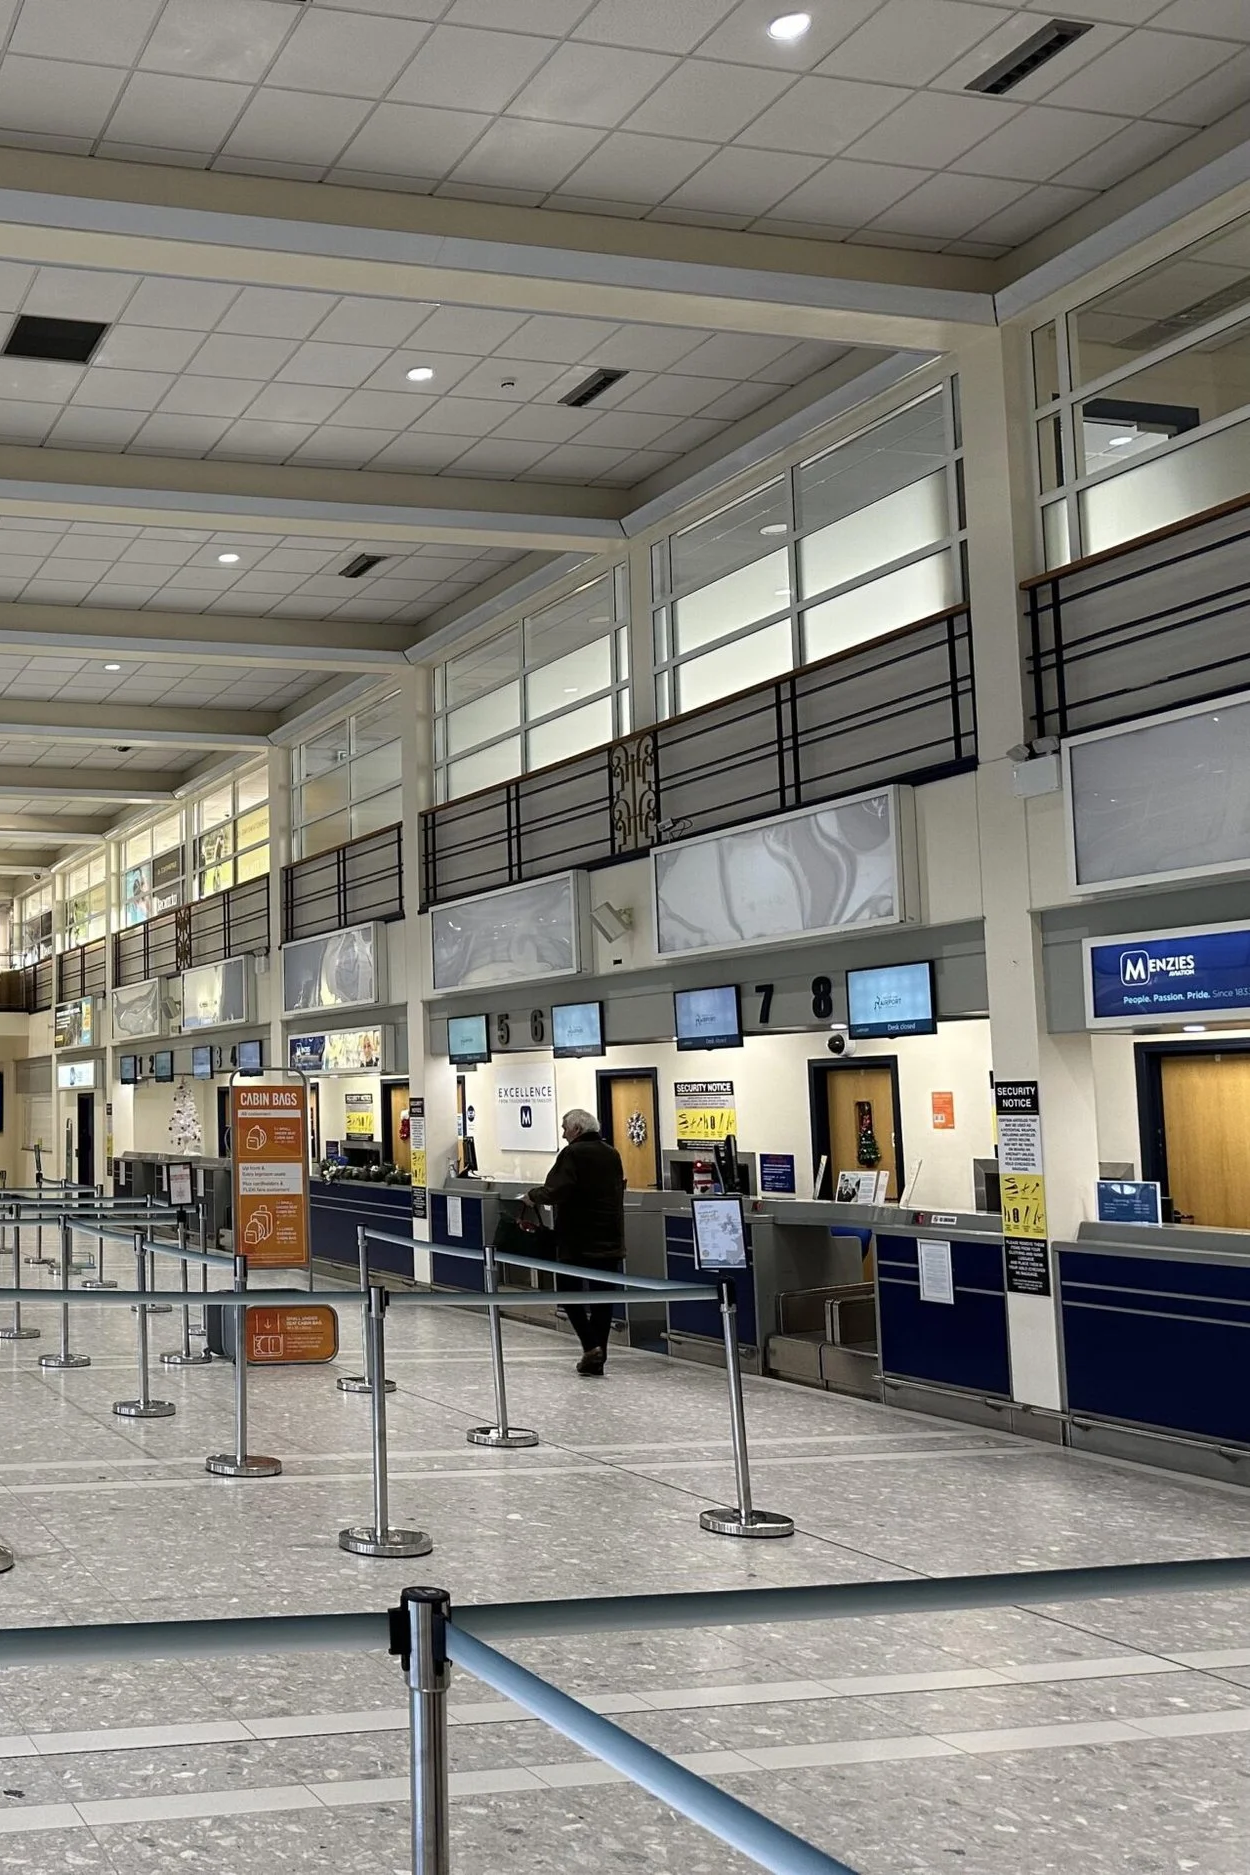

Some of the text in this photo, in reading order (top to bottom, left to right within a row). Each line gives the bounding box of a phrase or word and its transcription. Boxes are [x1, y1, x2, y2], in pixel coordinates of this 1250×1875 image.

[1124, 955, 1195, 981] MENZIES
[755, 984, 774, 1024] 7
[812, 976, 833, 1019] 8
[1123, 995, 1152, 1005] People.
[1153, 992, 1185, 1003] Passion.
[1187, 990, 1210, 1000] Pride.
[1212, 989, 1233, 999] Since
[497, 1013, 510, 1045] 5
[530, 1009, 544, 1043] 6
[138, 1056, 143, 1074] 1
[498, 1086, 552, 1098] EXCELLENCE
[676, 1082, 731, 1093] SECURITY NOTICE
[997, 1086, 1036, 1096] SECURITY
[240, 1092, 298, 1106] CABIN BAGS
[1002, 1098, 1032, 1108] NOTICE
